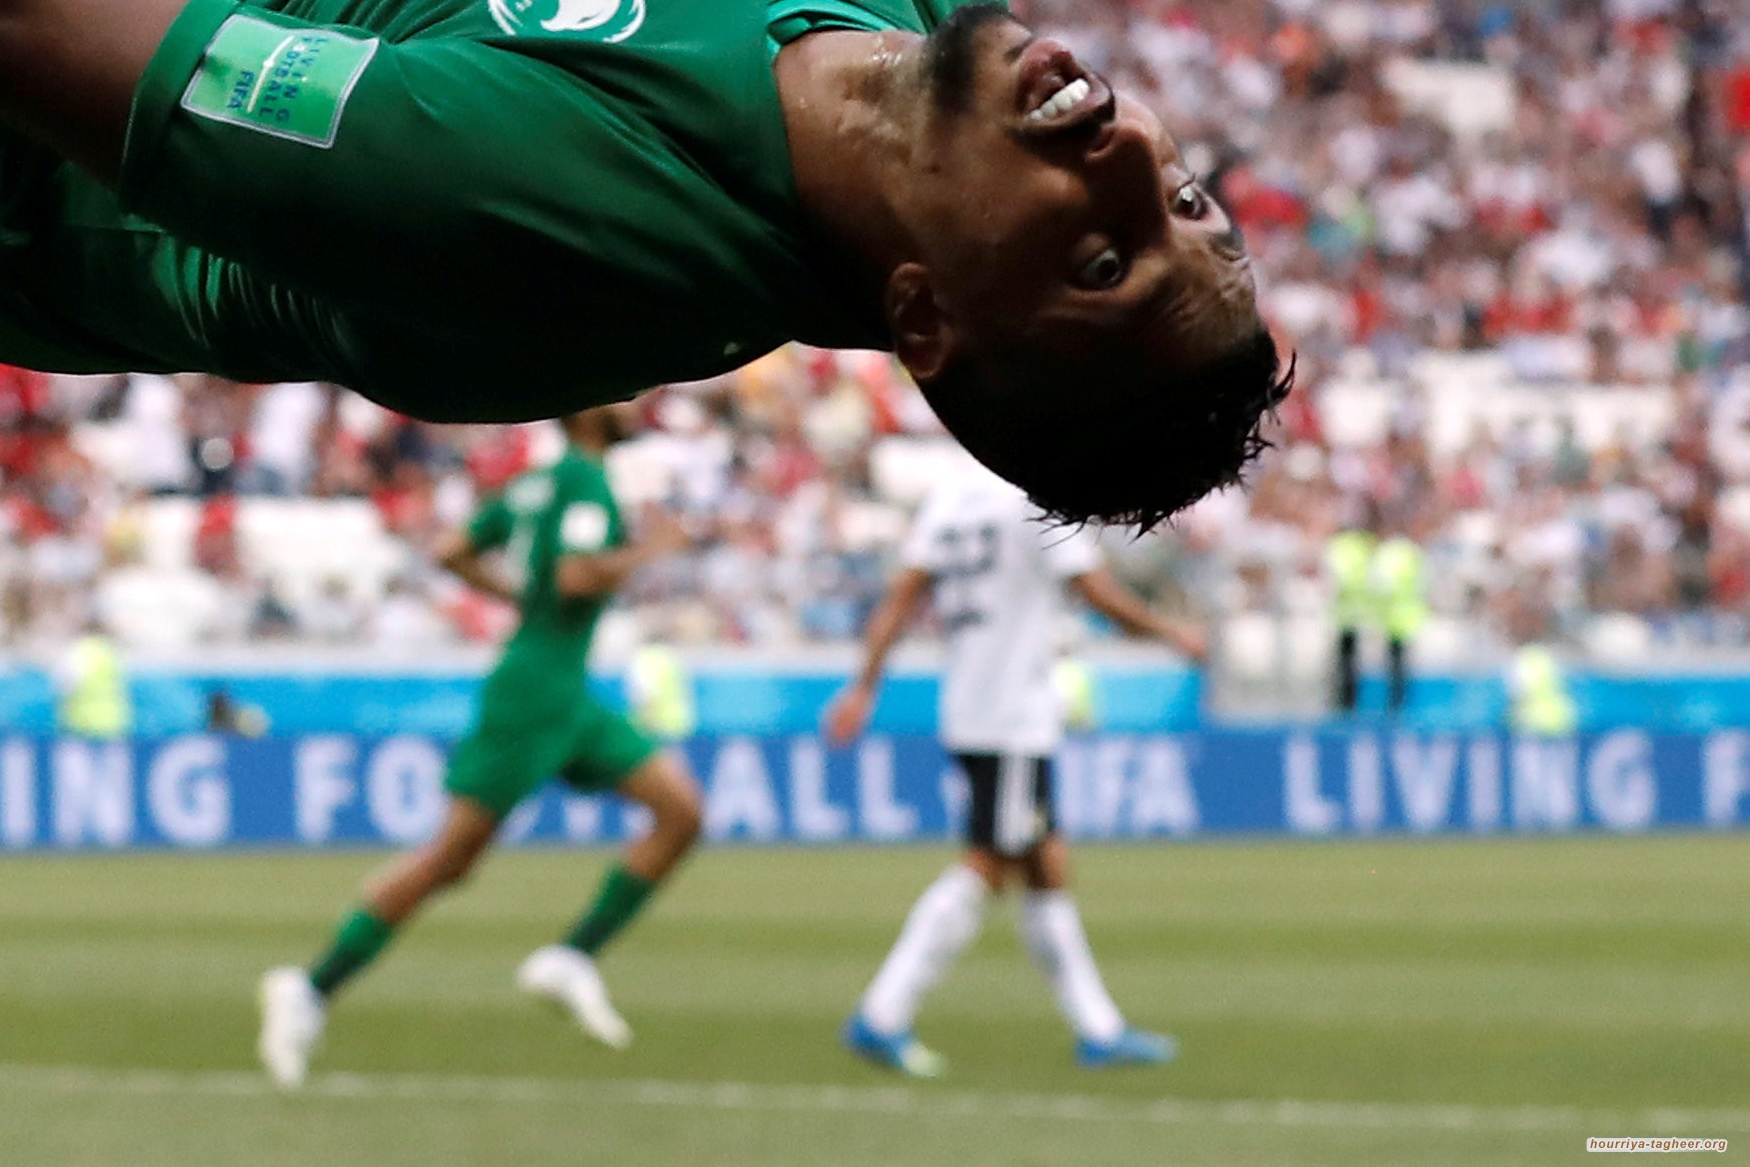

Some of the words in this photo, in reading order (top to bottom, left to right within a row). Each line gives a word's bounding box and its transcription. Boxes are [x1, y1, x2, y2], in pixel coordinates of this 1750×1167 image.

[226, 70, 254, 109] FIFA
[274, 36, 328, 123] LIVING
[293, 733, 919, 846] FOALL
[1283, 728, 1656, 833] LIVING
